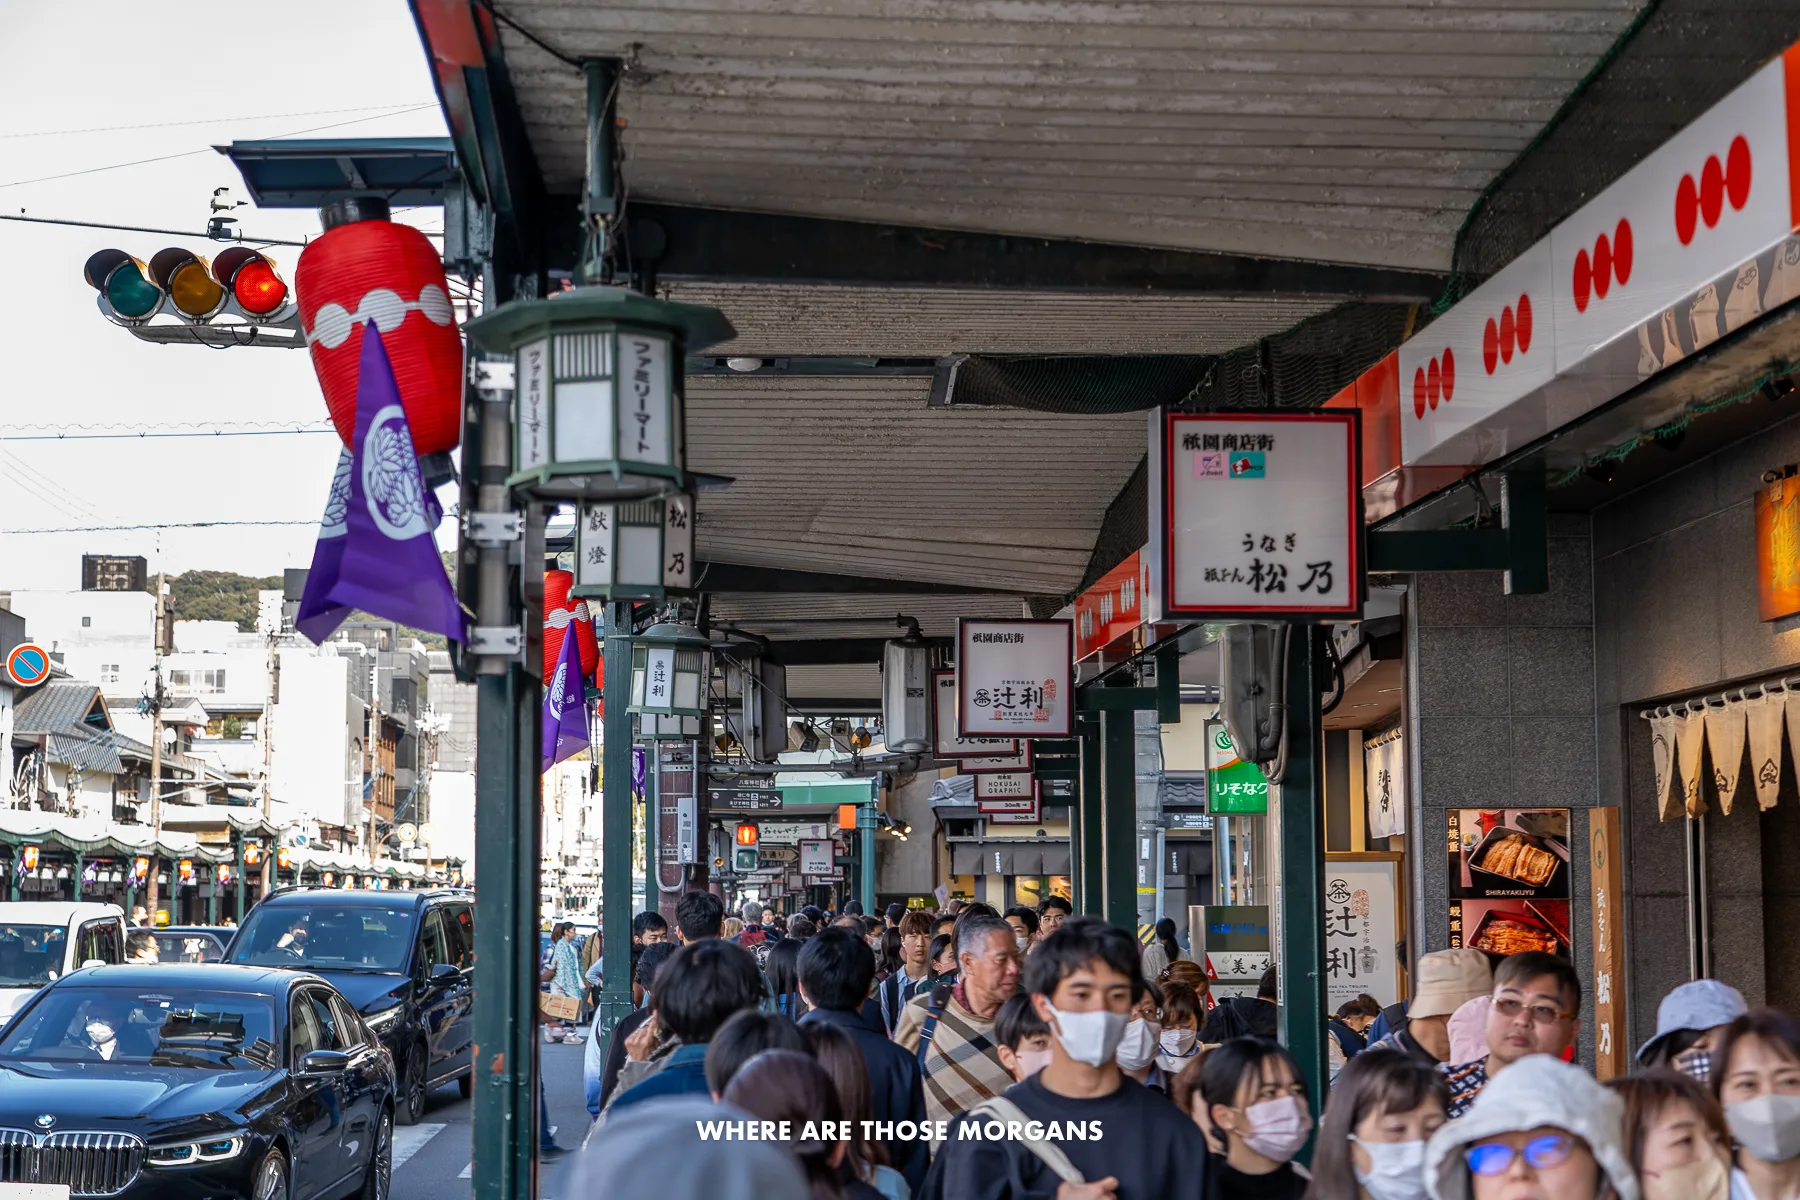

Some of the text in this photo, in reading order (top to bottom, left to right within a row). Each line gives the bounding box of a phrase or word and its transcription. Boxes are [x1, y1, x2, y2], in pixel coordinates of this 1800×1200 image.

[633, 341, 651, 454] ファミリーマート
[667, 504, 688, 575] 松乃
[1242, 533, 1297, 553] うなぎ
[1246, 557, 1334, 595] 松乃
[652, 670, 666, 697] 辻利
[993, 686, 1044, 710] 辻利
[1326, 906, 1357, 979] 辻利
[1207, 969, 1213, 977] 4
[1207, 1002, 1214, 1010] 3
